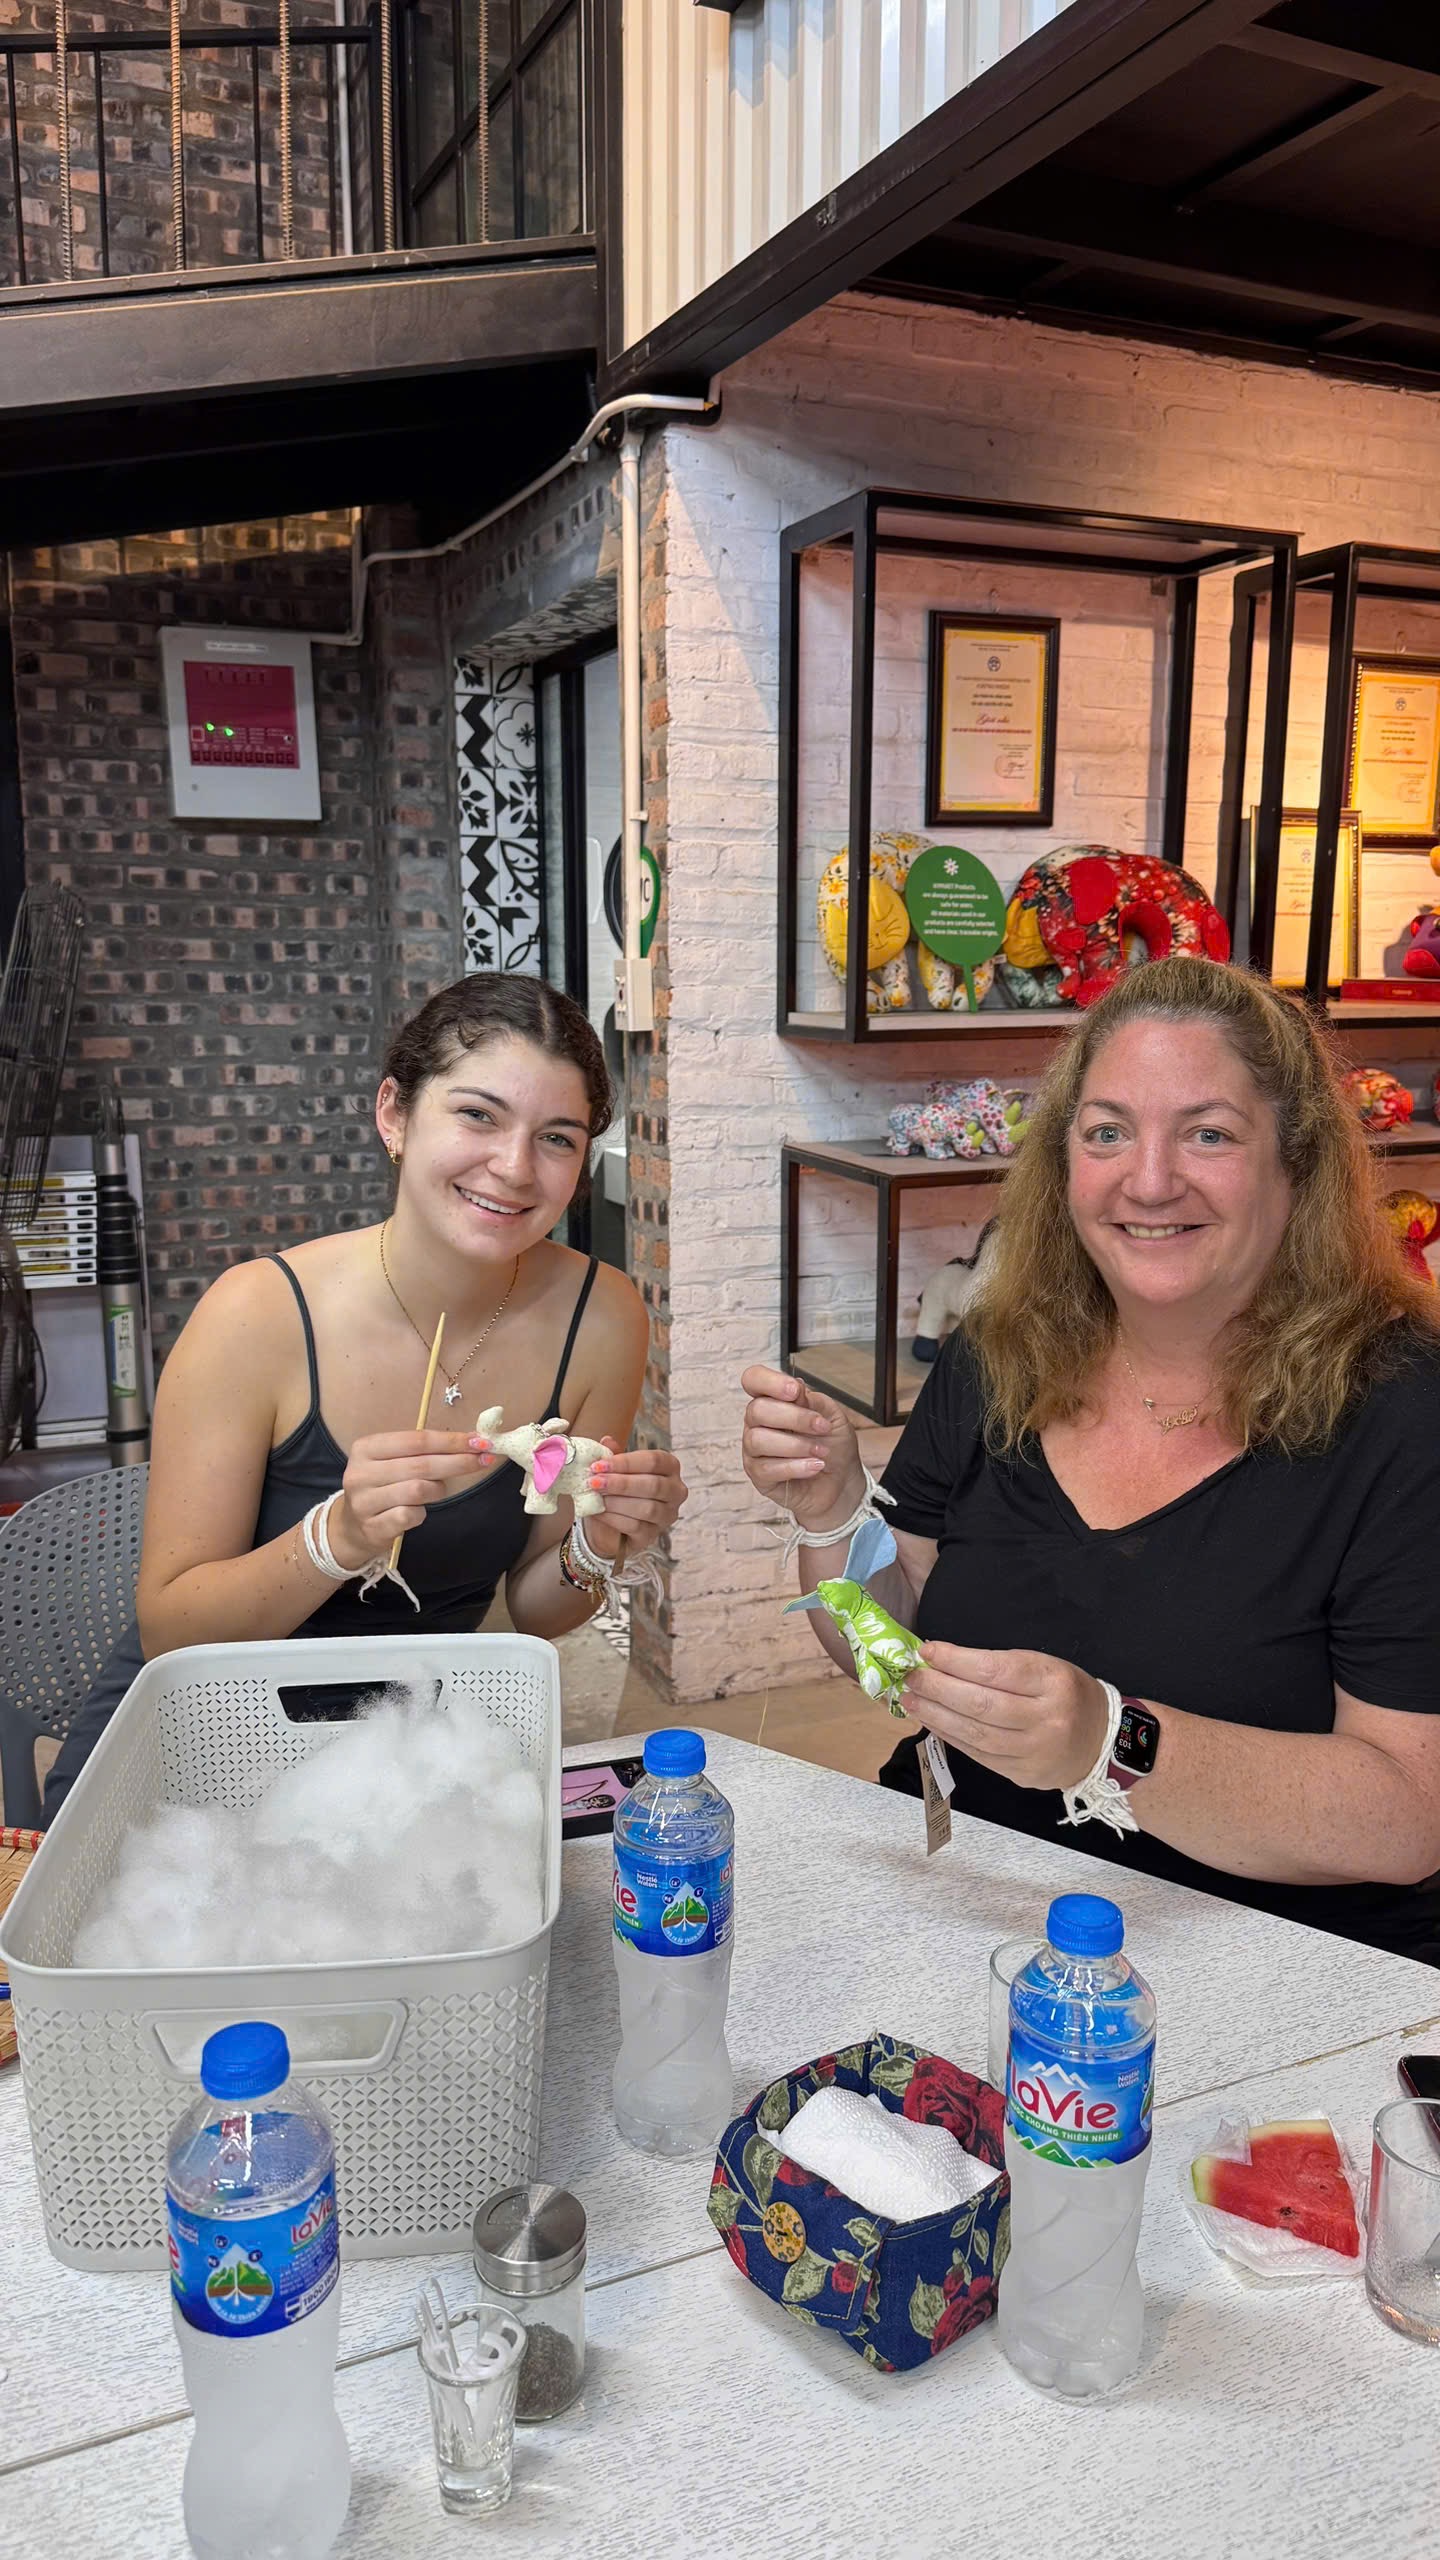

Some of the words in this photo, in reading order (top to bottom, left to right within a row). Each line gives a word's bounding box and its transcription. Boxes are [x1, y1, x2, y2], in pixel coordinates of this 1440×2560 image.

[1011, 2061, 1117, 2129] laVie
[1061, 2130, 1089, 2142] THIÊN
[1091, 2131, 1119, 2142] NHIÊN
